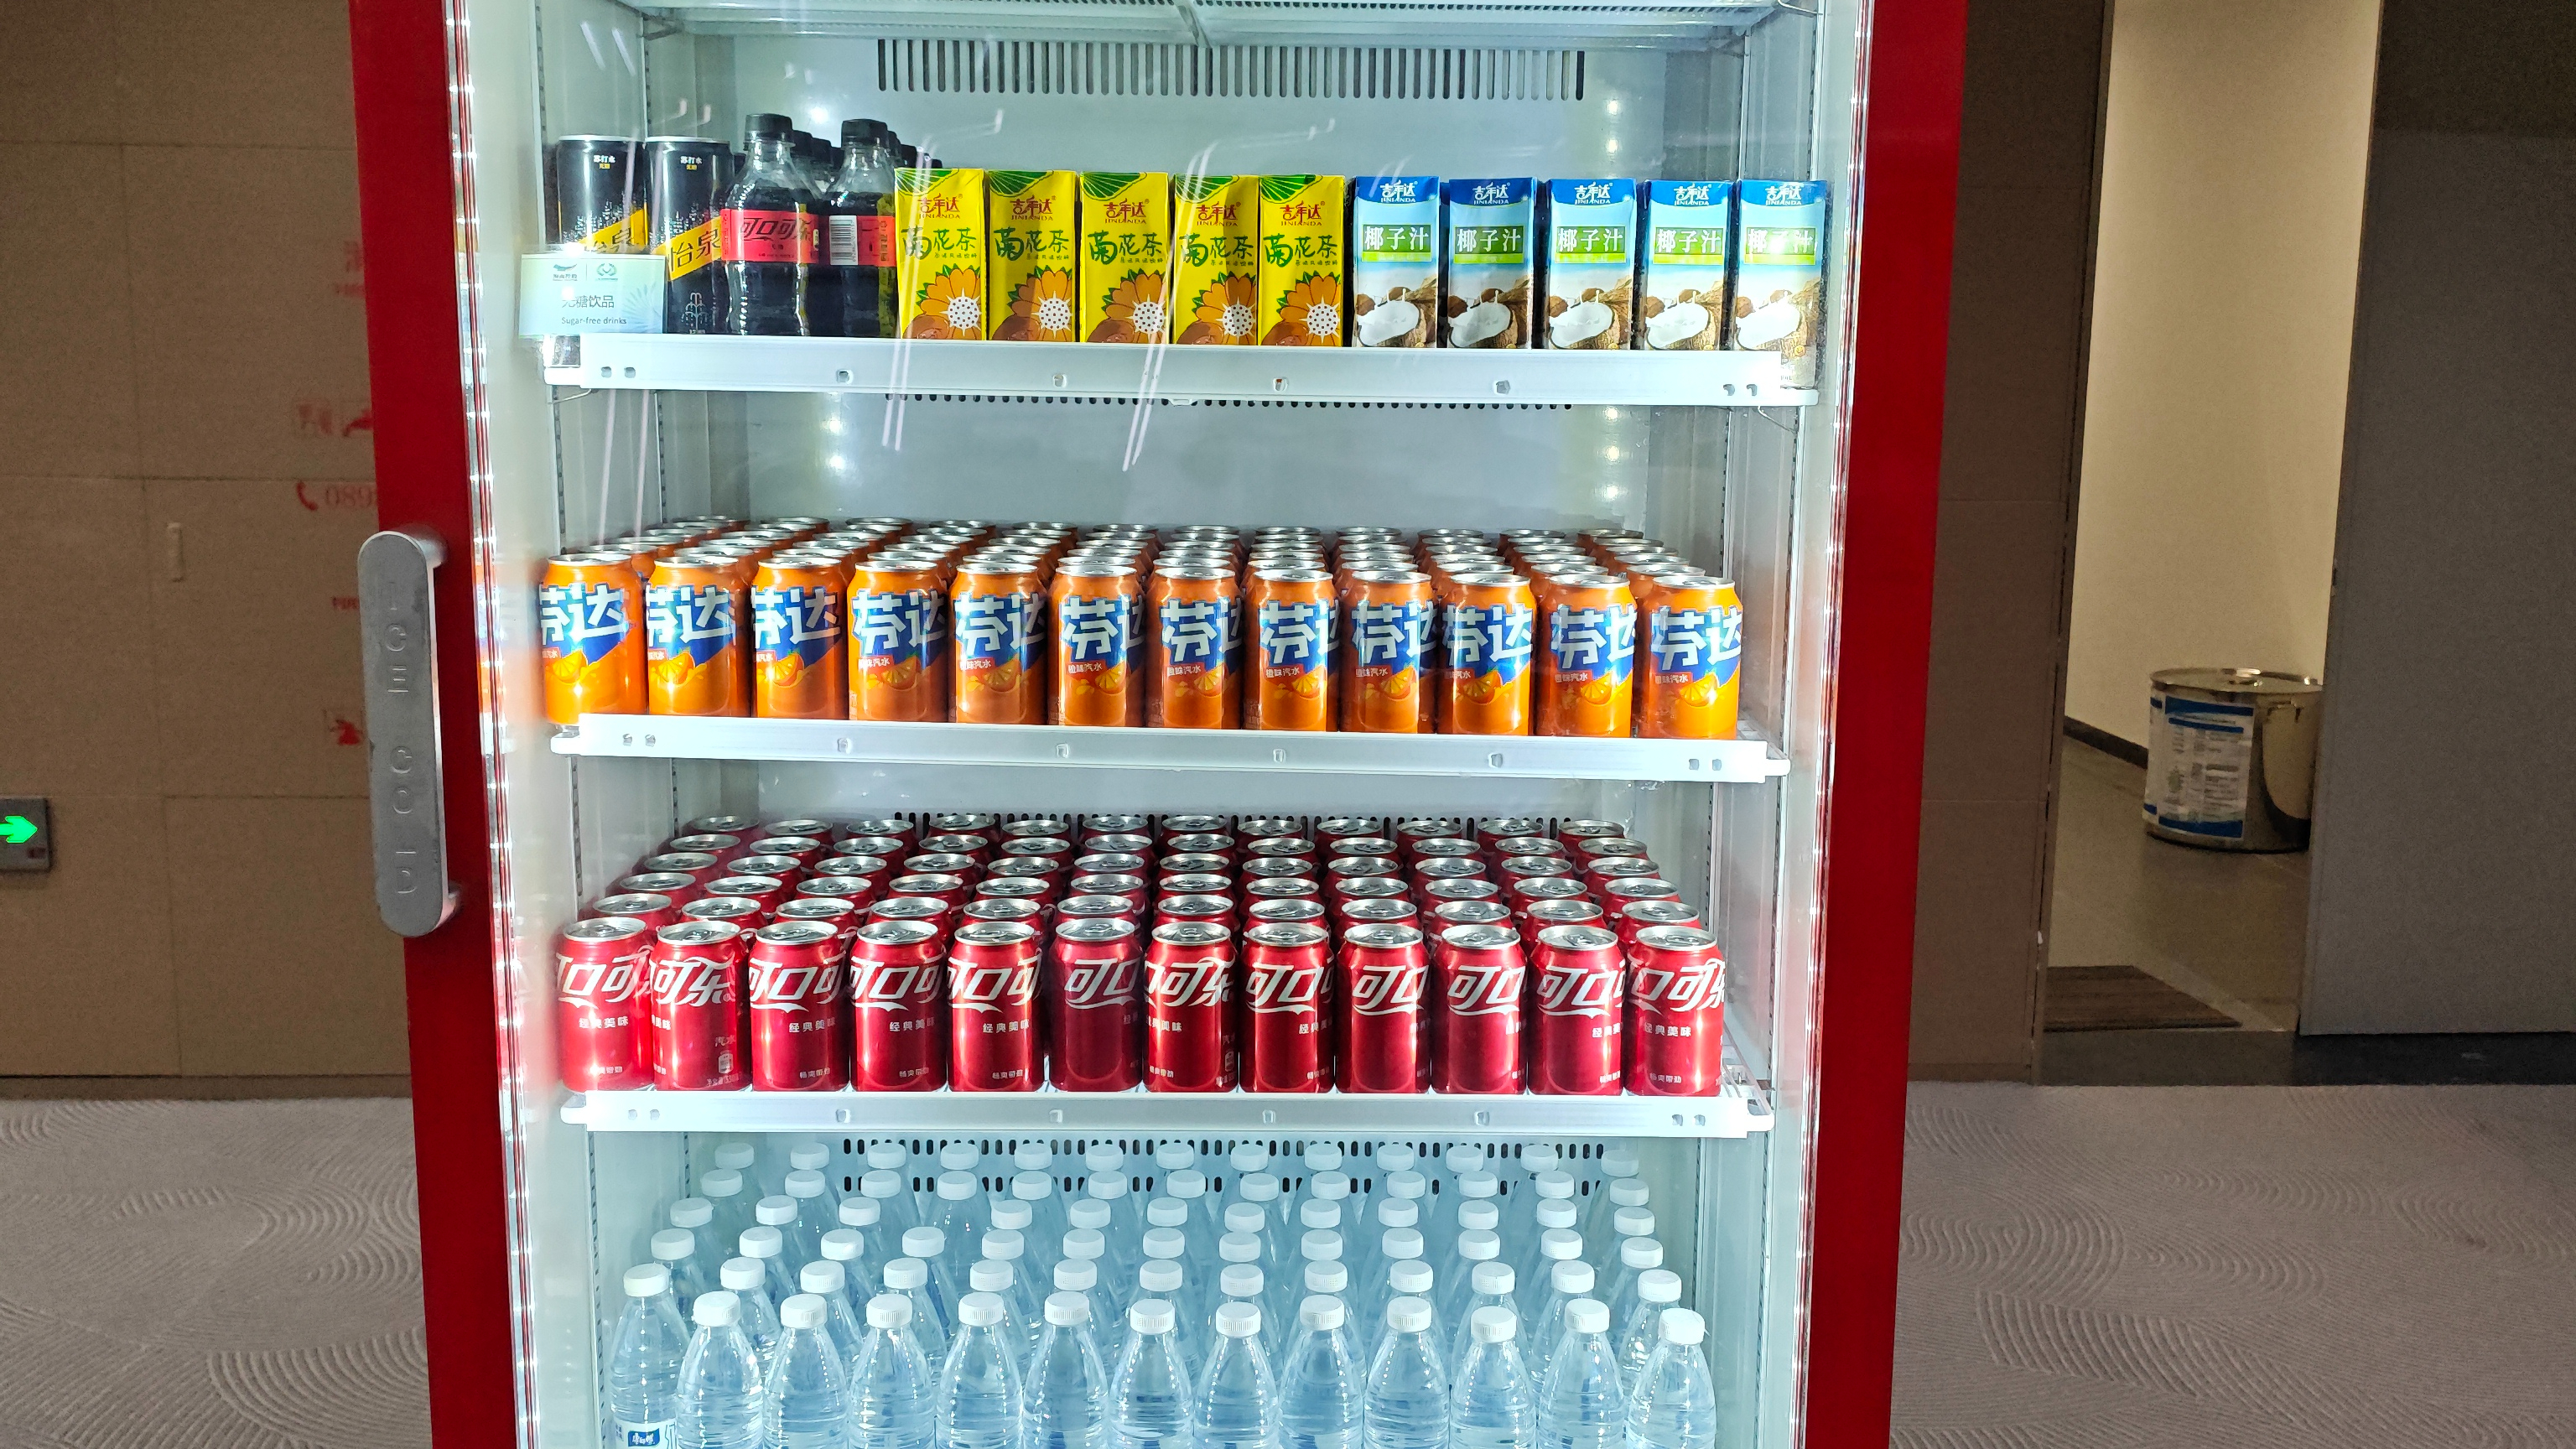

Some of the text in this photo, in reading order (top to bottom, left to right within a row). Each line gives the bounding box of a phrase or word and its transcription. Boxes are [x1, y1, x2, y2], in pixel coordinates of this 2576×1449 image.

[671, 228, 721, 273] 怡泉
[901, 226, 977, 260] 菊花茶
[994, 226, 1069, 261] 菊花茶
[1088, 230, 1162, 265] 菊花茶
[1179, 233, 1254, 267] 菊花茶
[1263, 233, 1337, 267] 菊花茶
[1364, 226, 1429, 251] 椰子汁
[1457, 228, 1521, 252] 椰子汁
[1558, 228, 1623, 252] 椰子汁
[1657, 229, 1722, 253] 椰子汁
[1748, 229, 1814, 253] 椰子汁
[562, 295, 615, 309] 无糖饮品
[562, 317, 601, 326] Sugar-free
[325, 485, 377, 508] 089
[646, 585, 736, 646] 芬达
[751, 585, 842, 646] 芬达
[852, 589, 946, 656] 芬达
[954, 591, 1046, 656] 芬达
[1061, 595, 1145, 660] 芬达
[1160, 597, 1243, 662] 芬达
[1352, 599, 1438, 665] 芬达
[1442, 603, 1534, 667] 芬达
[1551, 604, 1637, 668] 芬达
[1650, 605, 1742, 671] 芬达
[649, 953, 735, 1008] 可乐
